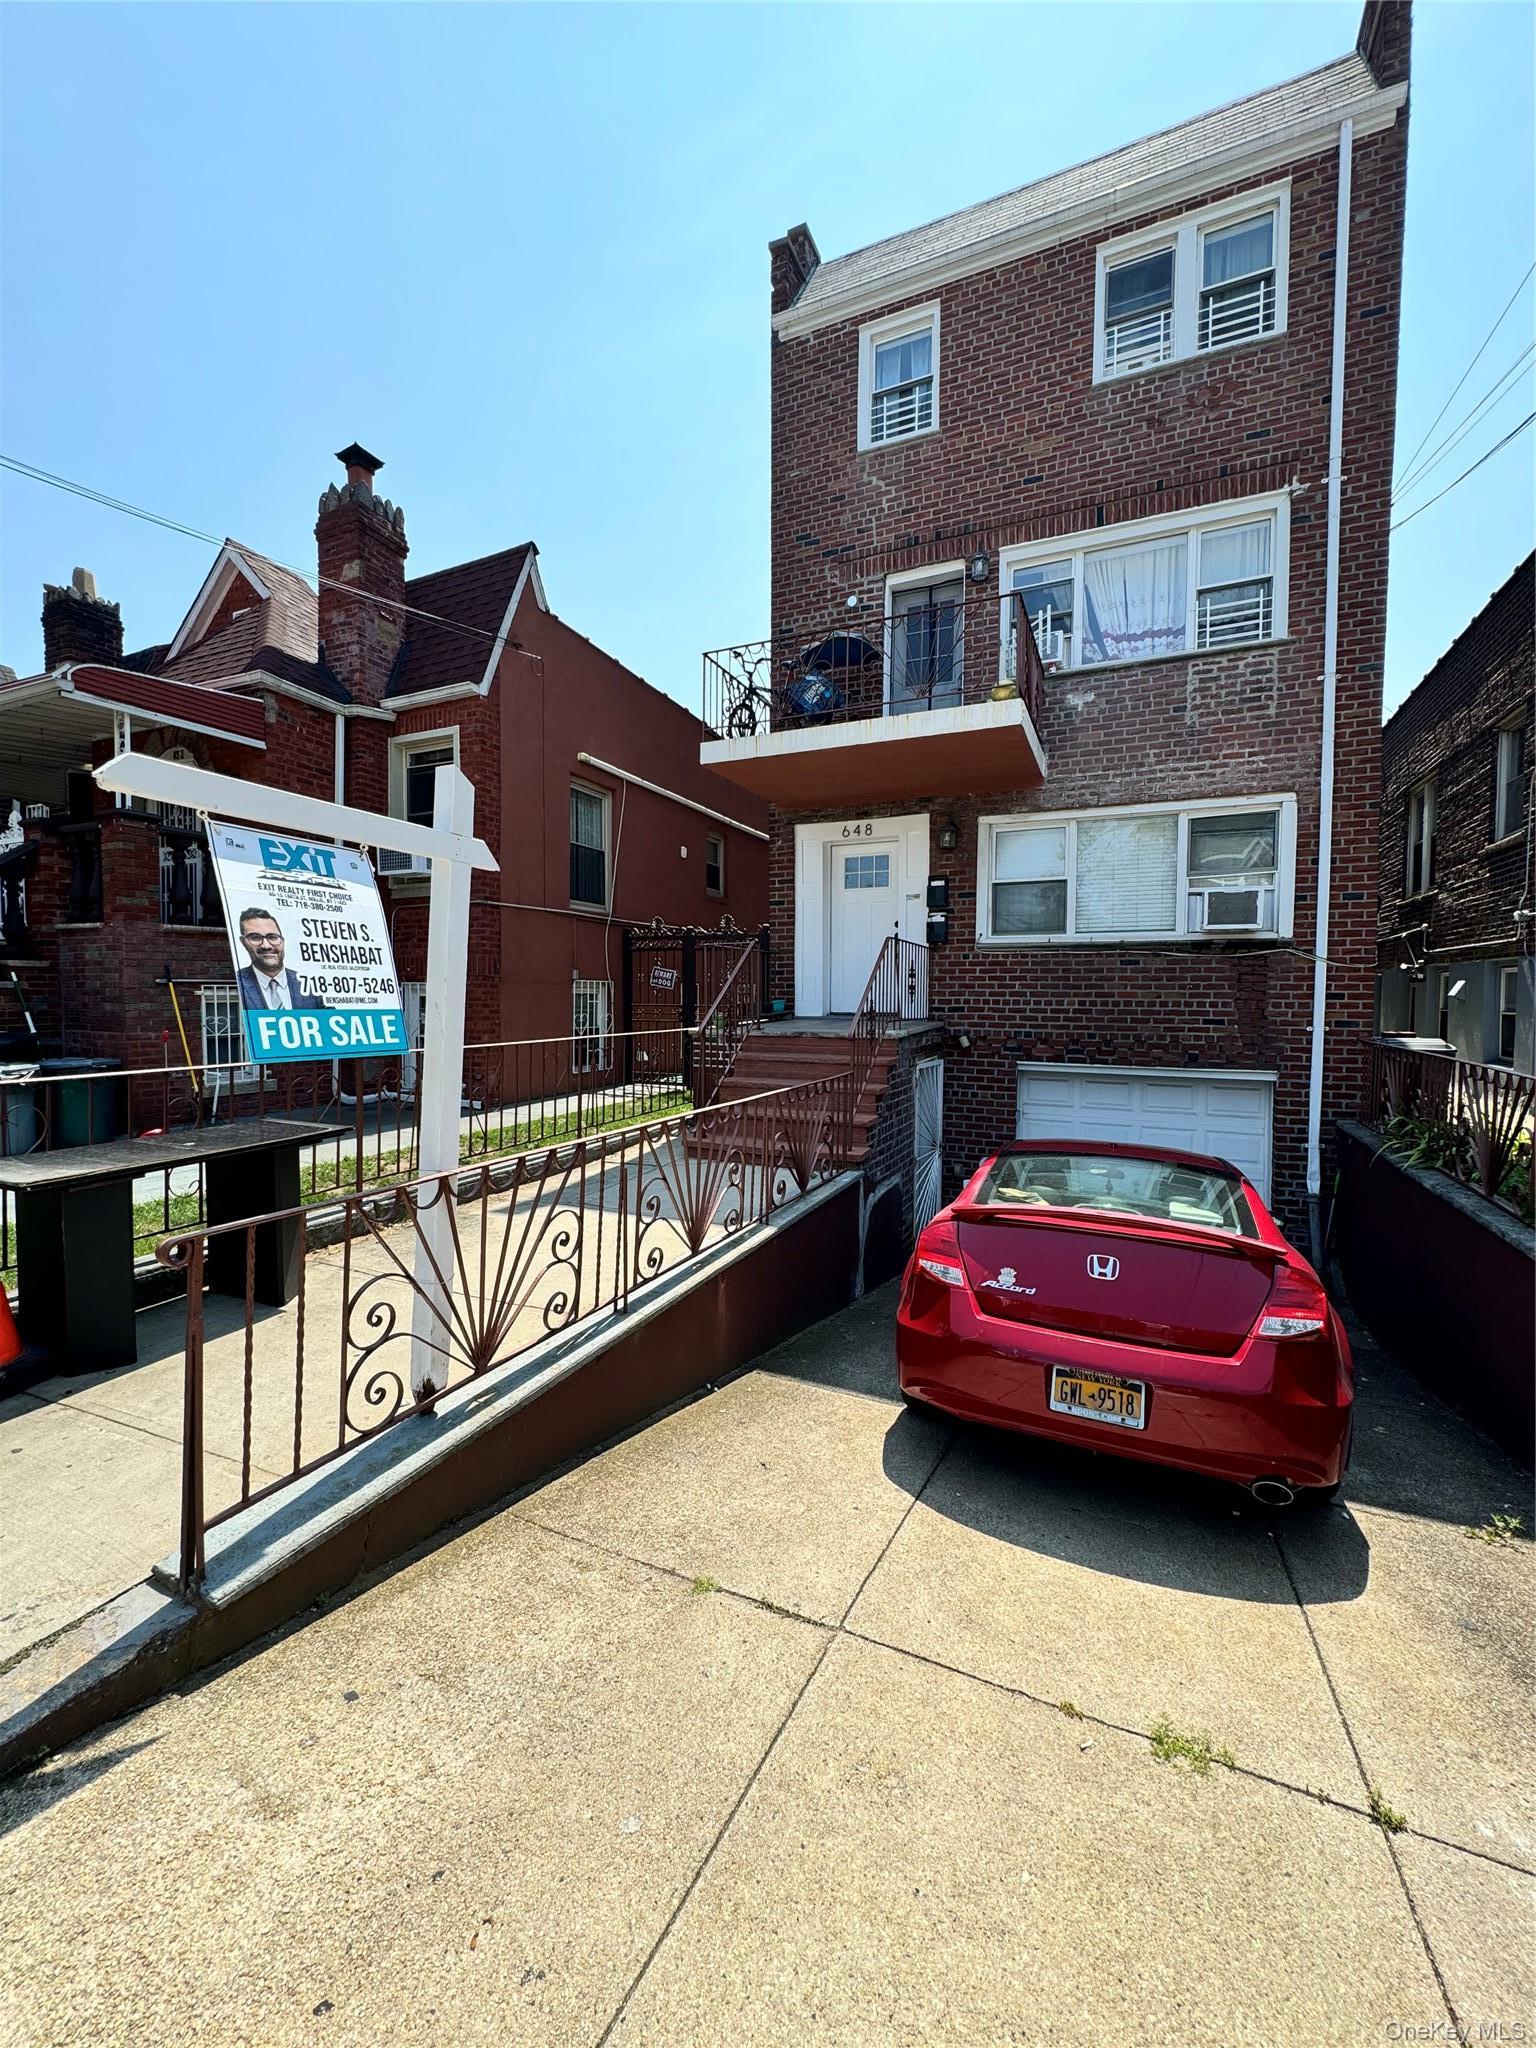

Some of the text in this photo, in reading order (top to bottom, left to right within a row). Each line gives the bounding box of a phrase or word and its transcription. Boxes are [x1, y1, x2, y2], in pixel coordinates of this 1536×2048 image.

[842, 823, 873, 838] 648
[257, 882, 353, 902] EXIT REALTY FIRST CHOICE
[276, 898, 343, 913] TEL: 718-380-2500
[301, 917, 374, 942] STEVEN S.
[299, 942, 383, 966] BENSHABAT
[299, 975, 395, 994] 718-807-5246
[258, 1015, 400, 1050] FOR SALE
[980, 1279, 1037, 1295] Accord
[1060, 1380, 1135, 1416] GWL 9518
